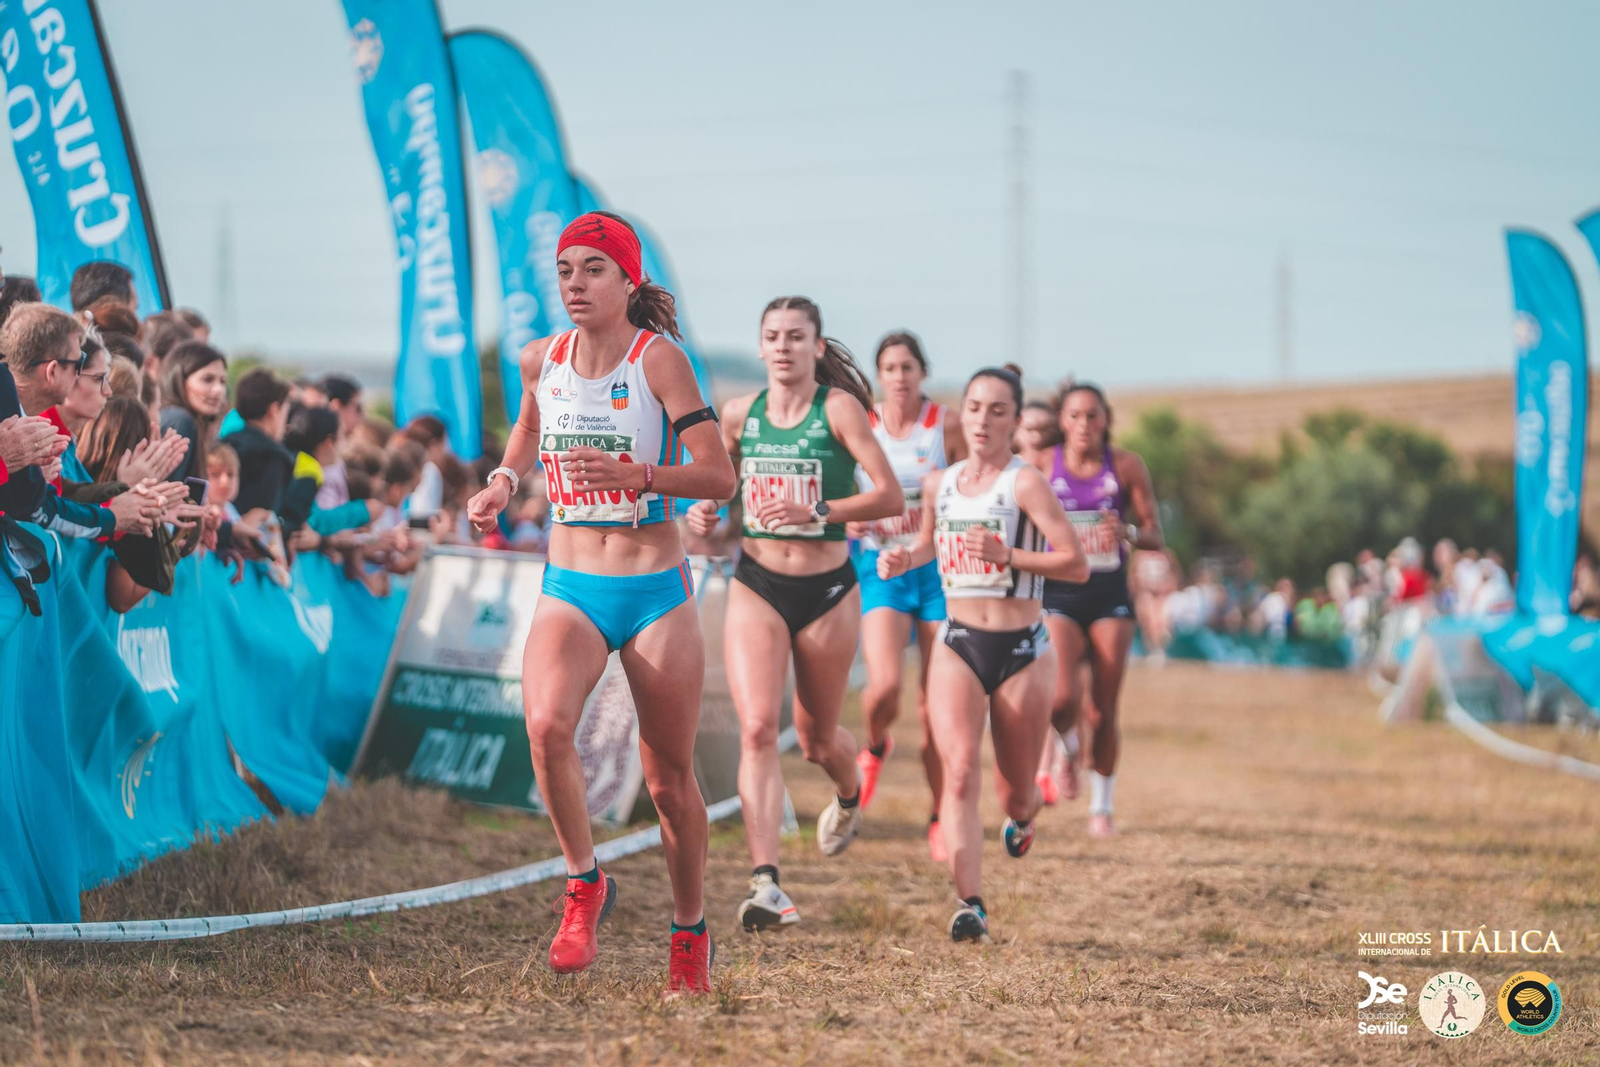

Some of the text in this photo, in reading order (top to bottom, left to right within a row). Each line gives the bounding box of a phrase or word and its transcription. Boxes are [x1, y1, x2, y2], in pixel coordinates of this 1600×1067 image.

[575, 423, 617, 431] de València
[576, 414, 611, 423] Diputació
[541, 453, 638, 506] BLAO
[937, 533, 1007, 575] GARO
